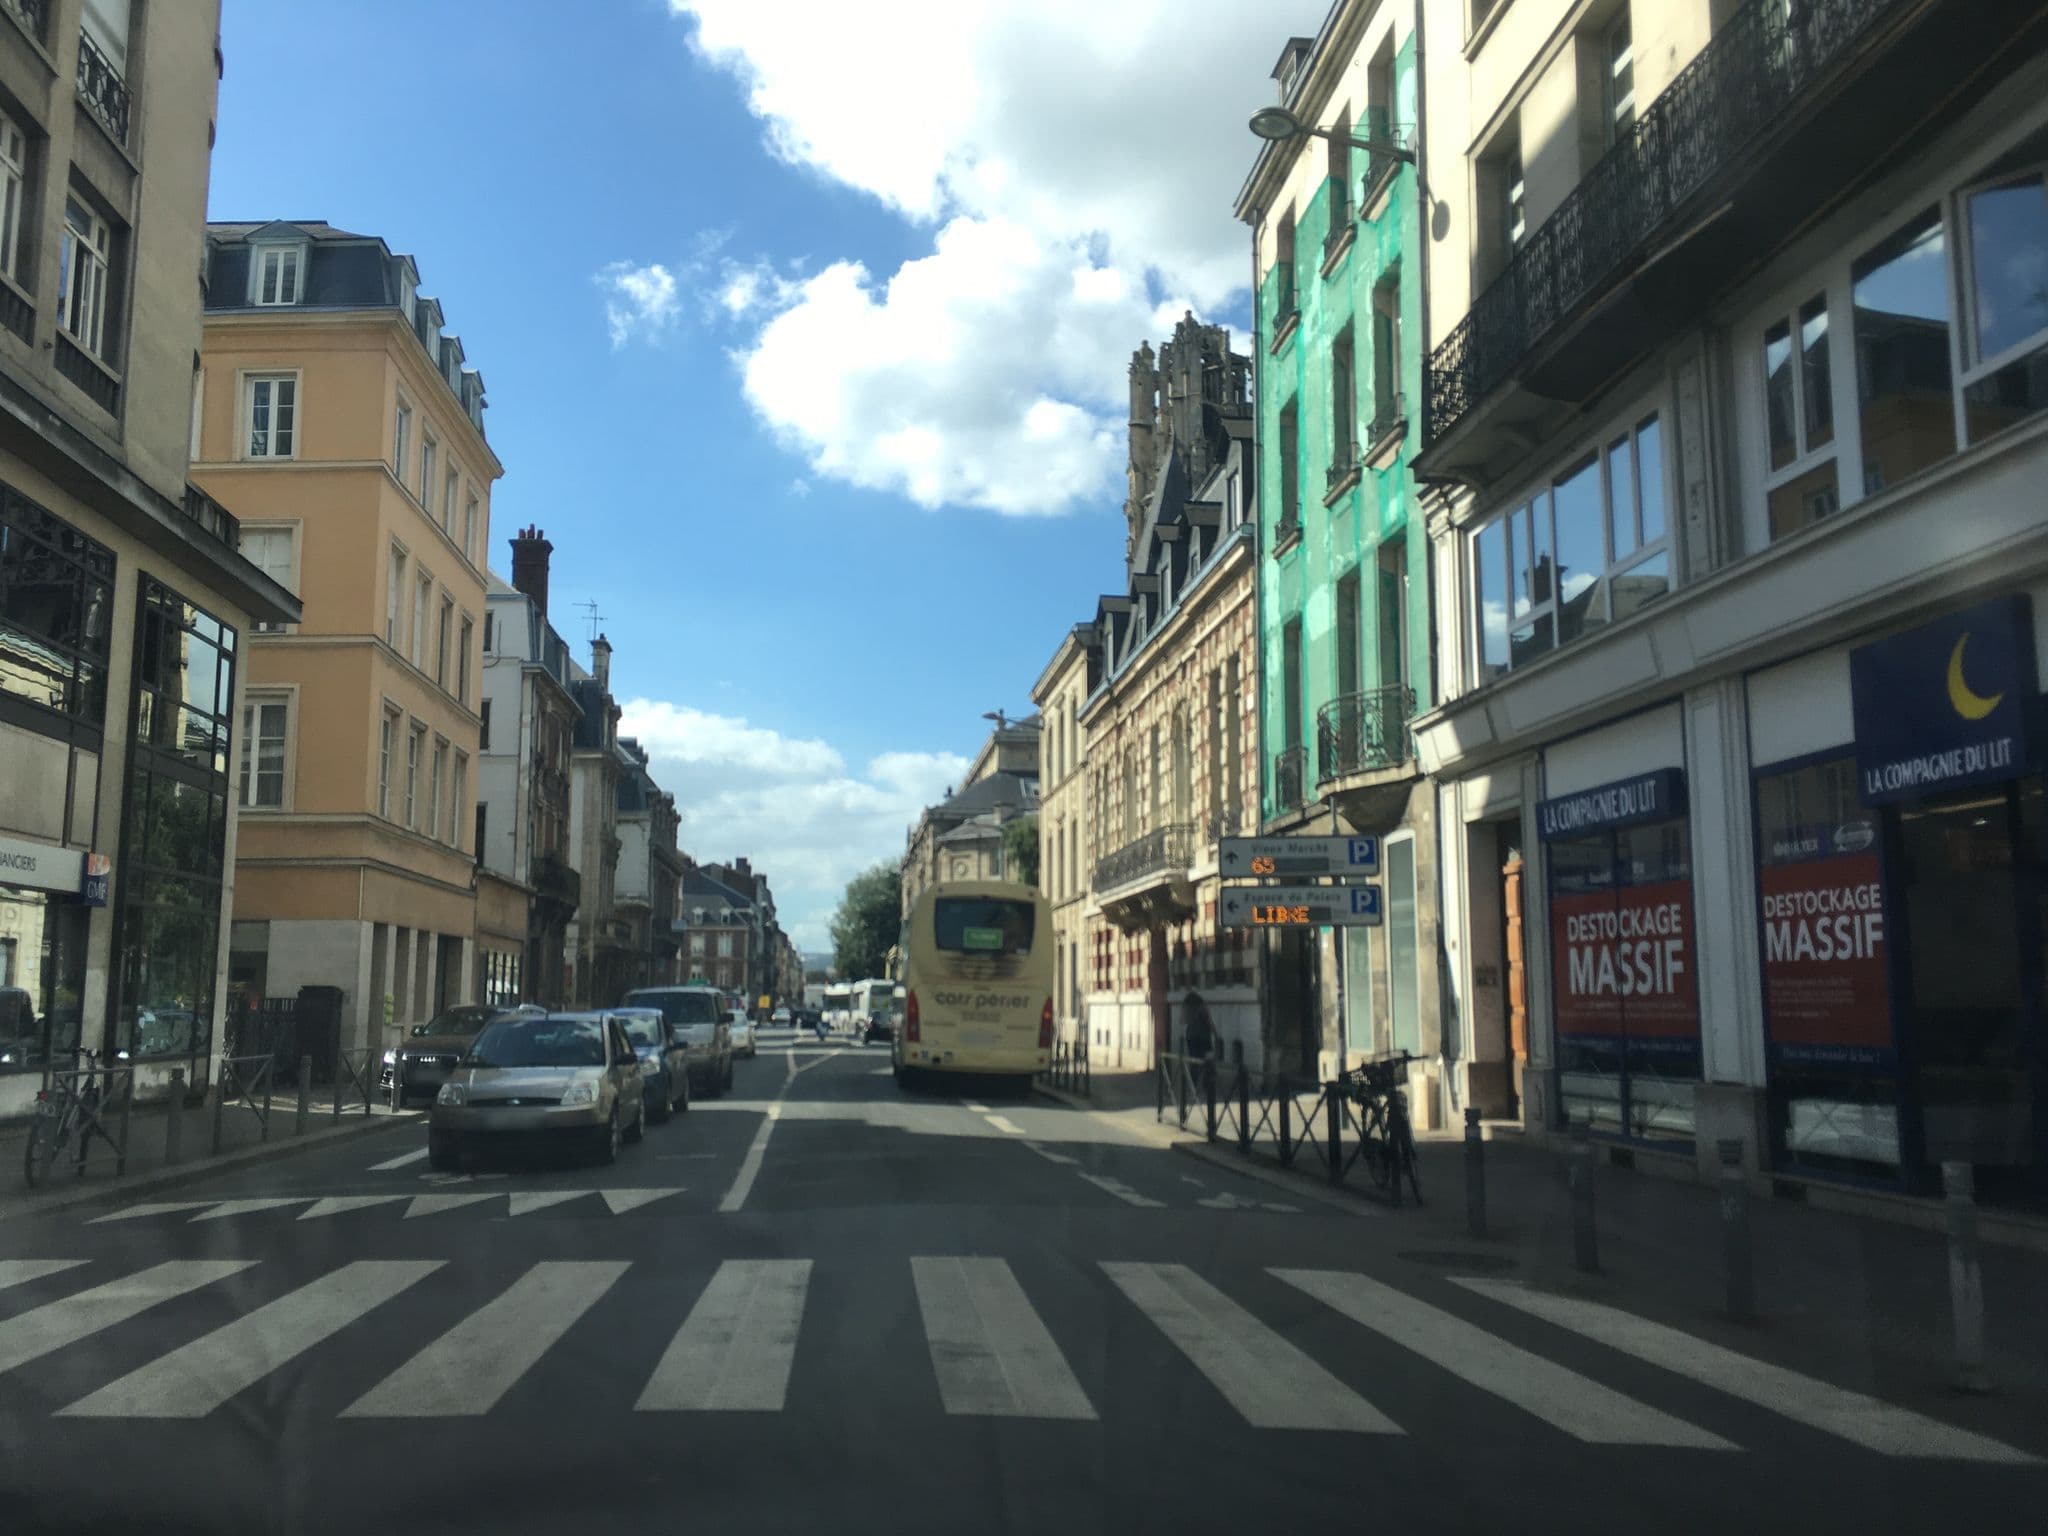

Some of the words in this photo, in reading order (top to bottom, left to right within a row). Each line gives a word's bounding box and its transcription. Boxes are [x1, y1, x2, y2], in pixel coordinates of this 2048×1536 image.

[1867, 768, 1884, 795] LA
[1885, 749, 1963, 790] COMPAGNIE
[1965, 744, 1986, 774] DU
[1989, 738, 2011, 768] LIT
[1544, 804, 1558, 833] LA
[1559, 790, 1619, 831] COMPAGNIE
[1620, 785, 1637, 816] DU
[1638, 780, 1656, 812] LIT
[0, 852, 36, 872] ANCIERS
[1251, 905, 1310, 923] LIBRE
[1764, 883, 1882, 918] DESTOCKAGE
[1567, 904, 1682, 942] DESTOCKAGE
[1766, 913, 1884, 962] MASSIF
[1569, 939, 1684, 995] MASSIF
